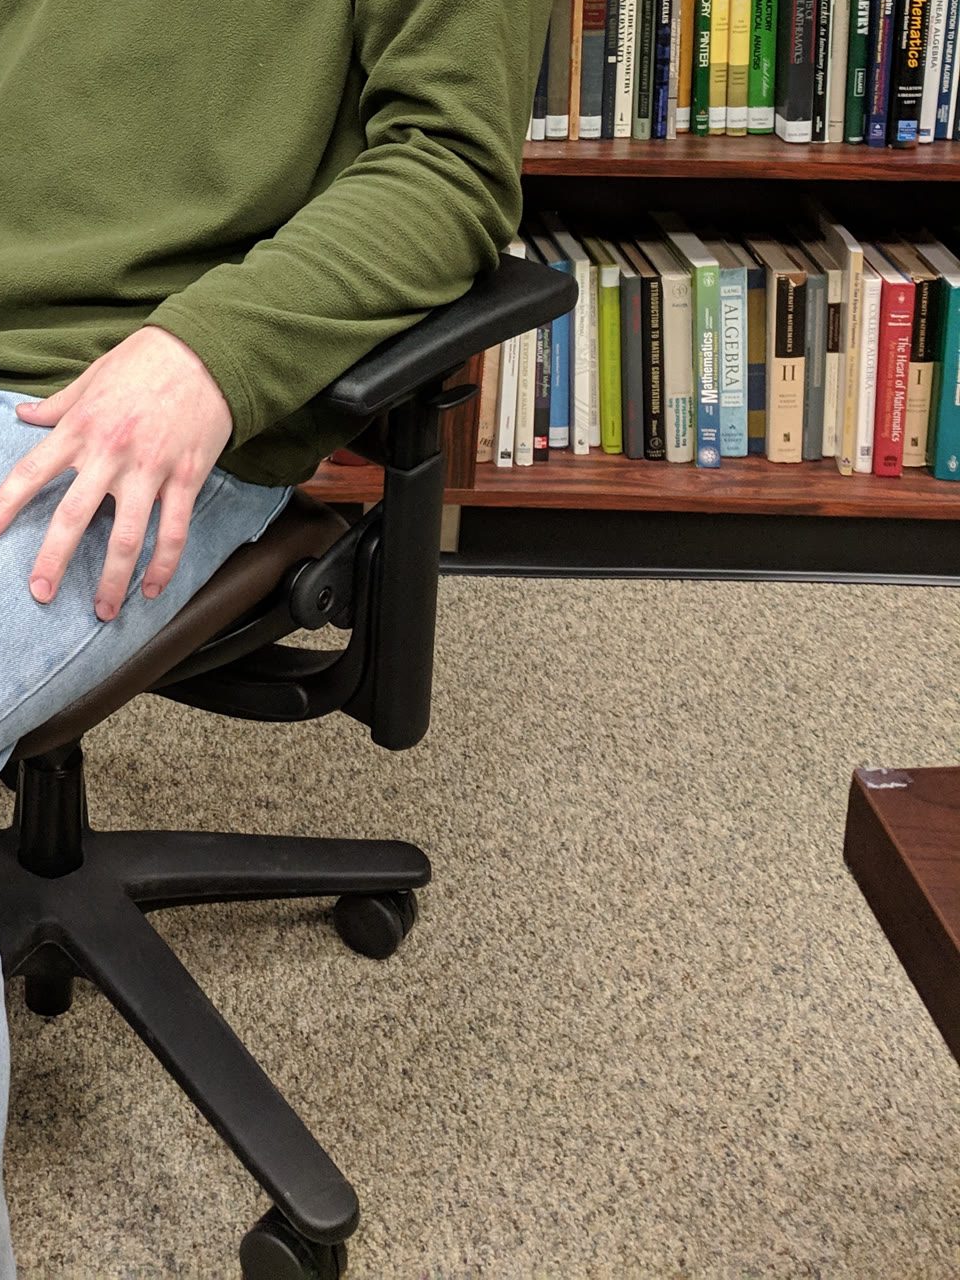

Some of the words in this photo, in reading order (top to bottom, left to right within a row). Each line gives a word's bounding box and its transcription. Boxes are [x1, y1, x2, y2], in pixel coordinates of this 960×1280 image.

[698, 31, 710, 68] PINTER
[751, 34, 762, 71] ANALYSIS
[649, 281, 659, 328] INTRODUCTION
[651, 329, 659, 339] TO
[867, 303, 878, 346] COLLEGE
[651, 340, 660, 365] MATRIX
[723, 303, 740, 387] ALGEBRA
[898, 335, 909, 353] The
[700, 331, 719, 405] Mathematics
[781, 364, 796, 382] II
[864, 347, 877, 391] ALGEBRA
[896, 353, 908, 378] Heart
[651, 365, 661, 415] COMPUTATIONS
[897, 379, 906, 390] of
[891, 390, 906, 443] Mathematics
